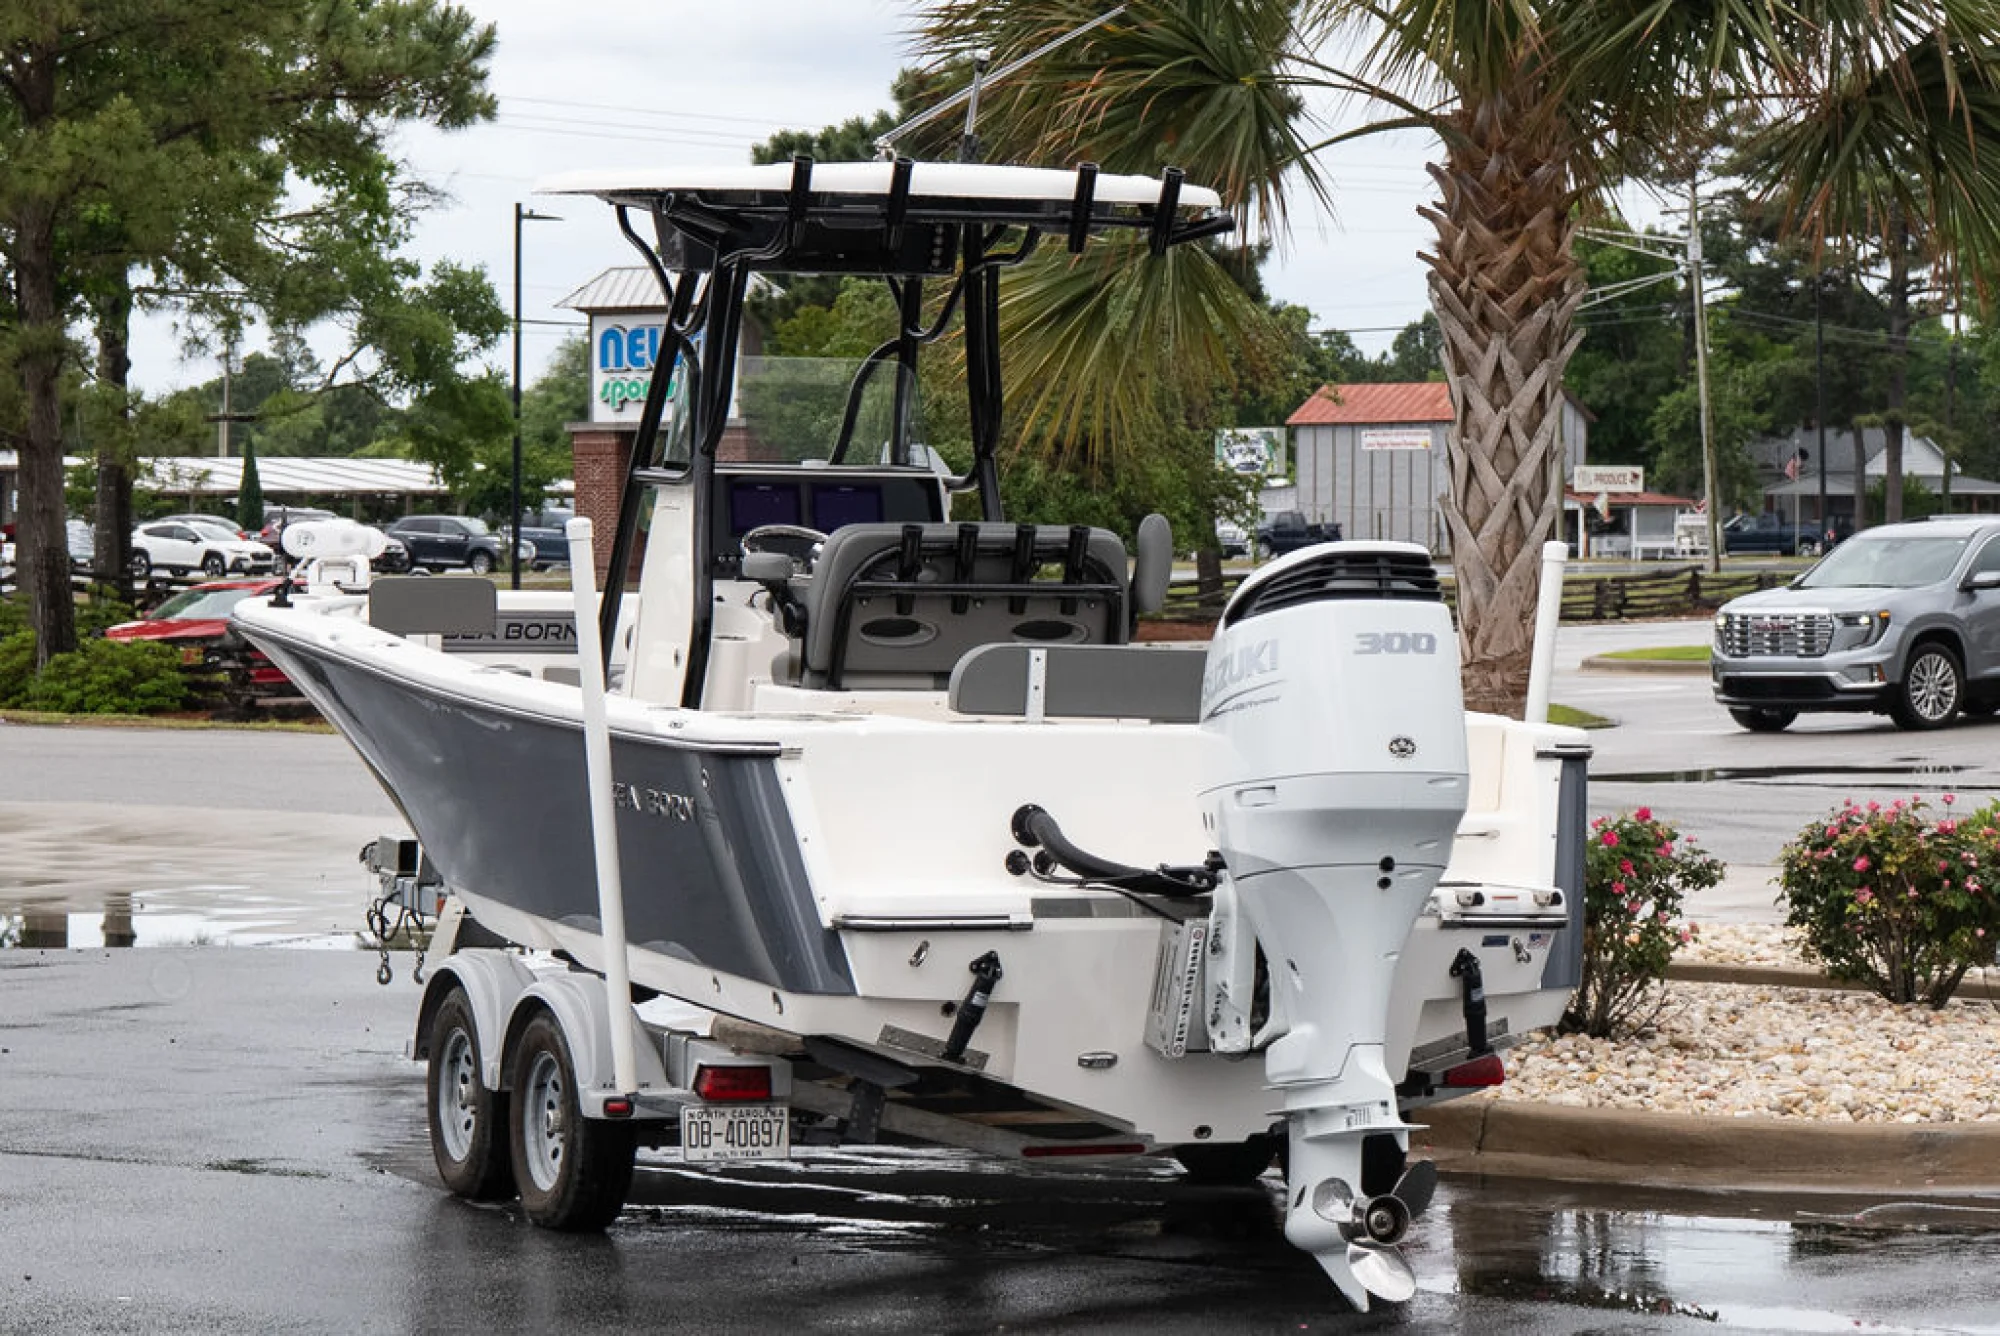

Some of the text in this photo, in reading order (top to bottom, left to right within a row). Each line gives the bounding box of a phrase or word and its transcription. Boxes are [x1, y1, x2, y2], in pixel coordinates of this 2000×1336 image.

[1594, 472, 1627, 485] PRODUCE
[505, 622, 577, 640] BORN
[1354, 632, 1437, 654] 300
[612, 782, 695, 821] EA BORN
